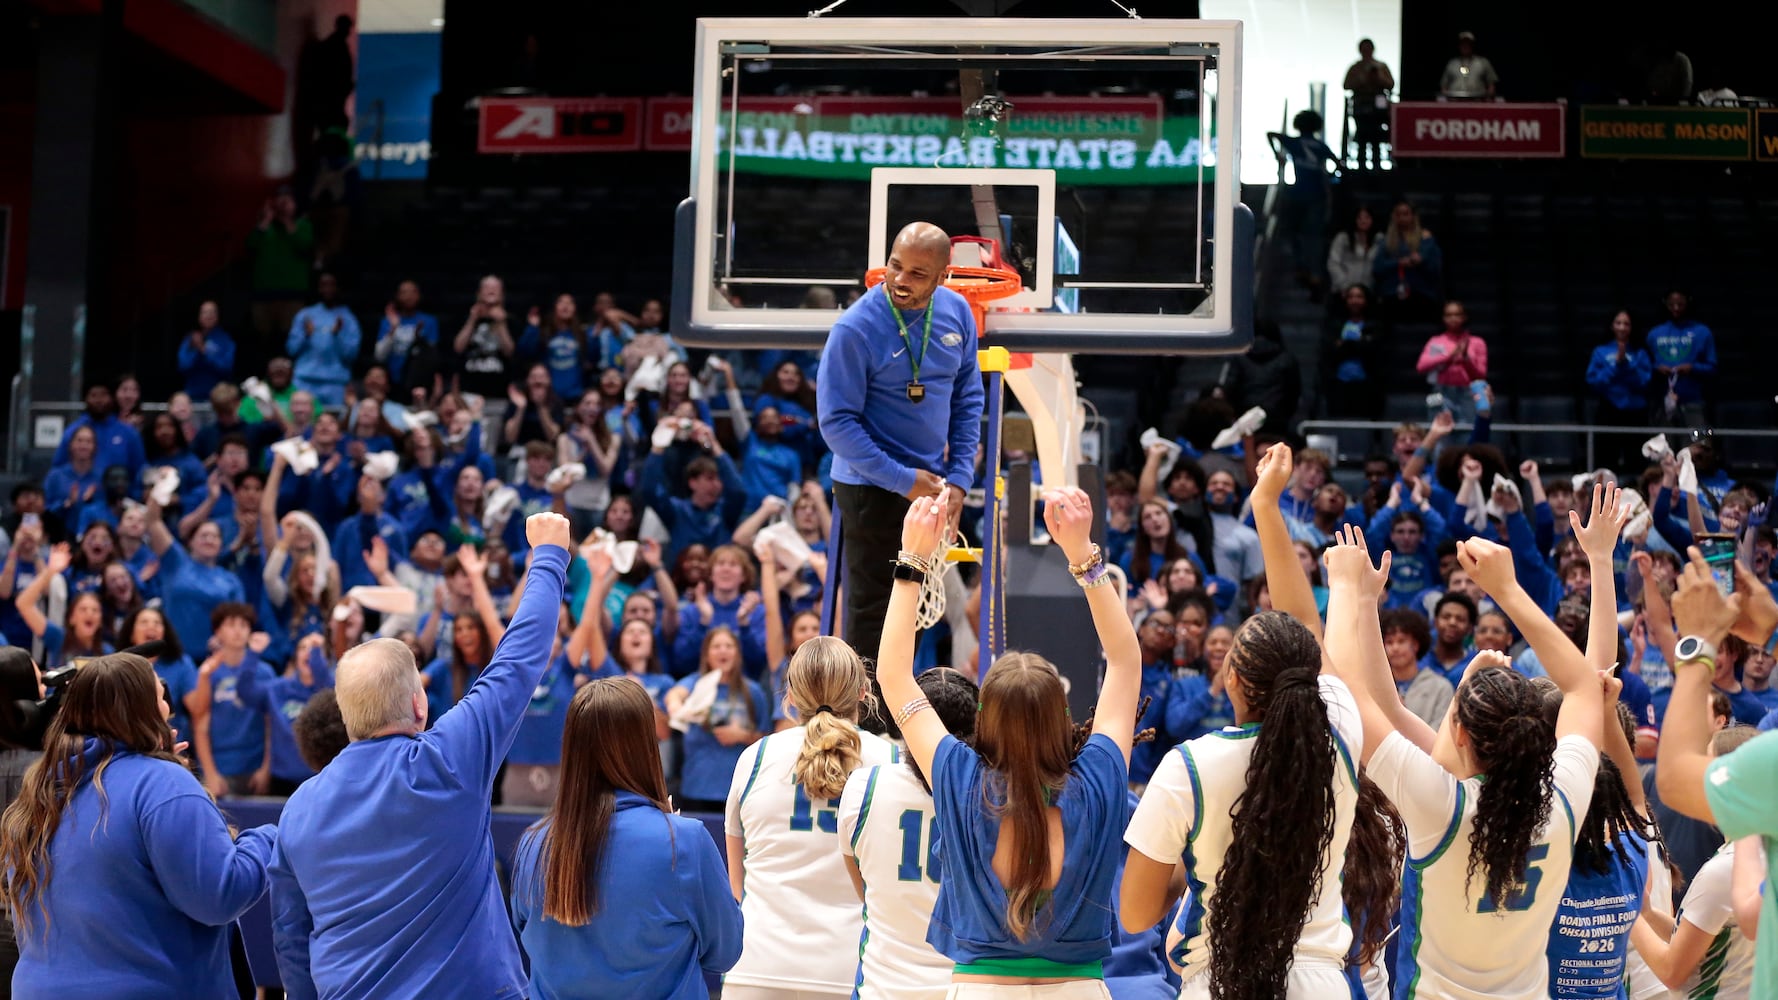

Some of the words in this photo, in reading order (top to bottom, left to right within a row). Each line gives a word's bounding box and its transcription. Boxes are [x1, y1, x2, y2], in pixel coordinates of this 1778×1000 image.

[495, 106, 625, 139] A10
[850, 112, 949, 134] DAYTON
[1007, 111, 1144, 134] DUQUESNE
[1415, 119, 1541, 141] FORDHAM
[1584, 122, 1667, 139] GEORGE
[1674, 123, 1749, 141] MASON
[1592, 913, 1617, 926] FINAL
[1559, 926, 1591, 939] OHSAA
[1560, 958, 1593, 967] SECTIONAL
[1556, 976, 1589, 986] DISTRICT
